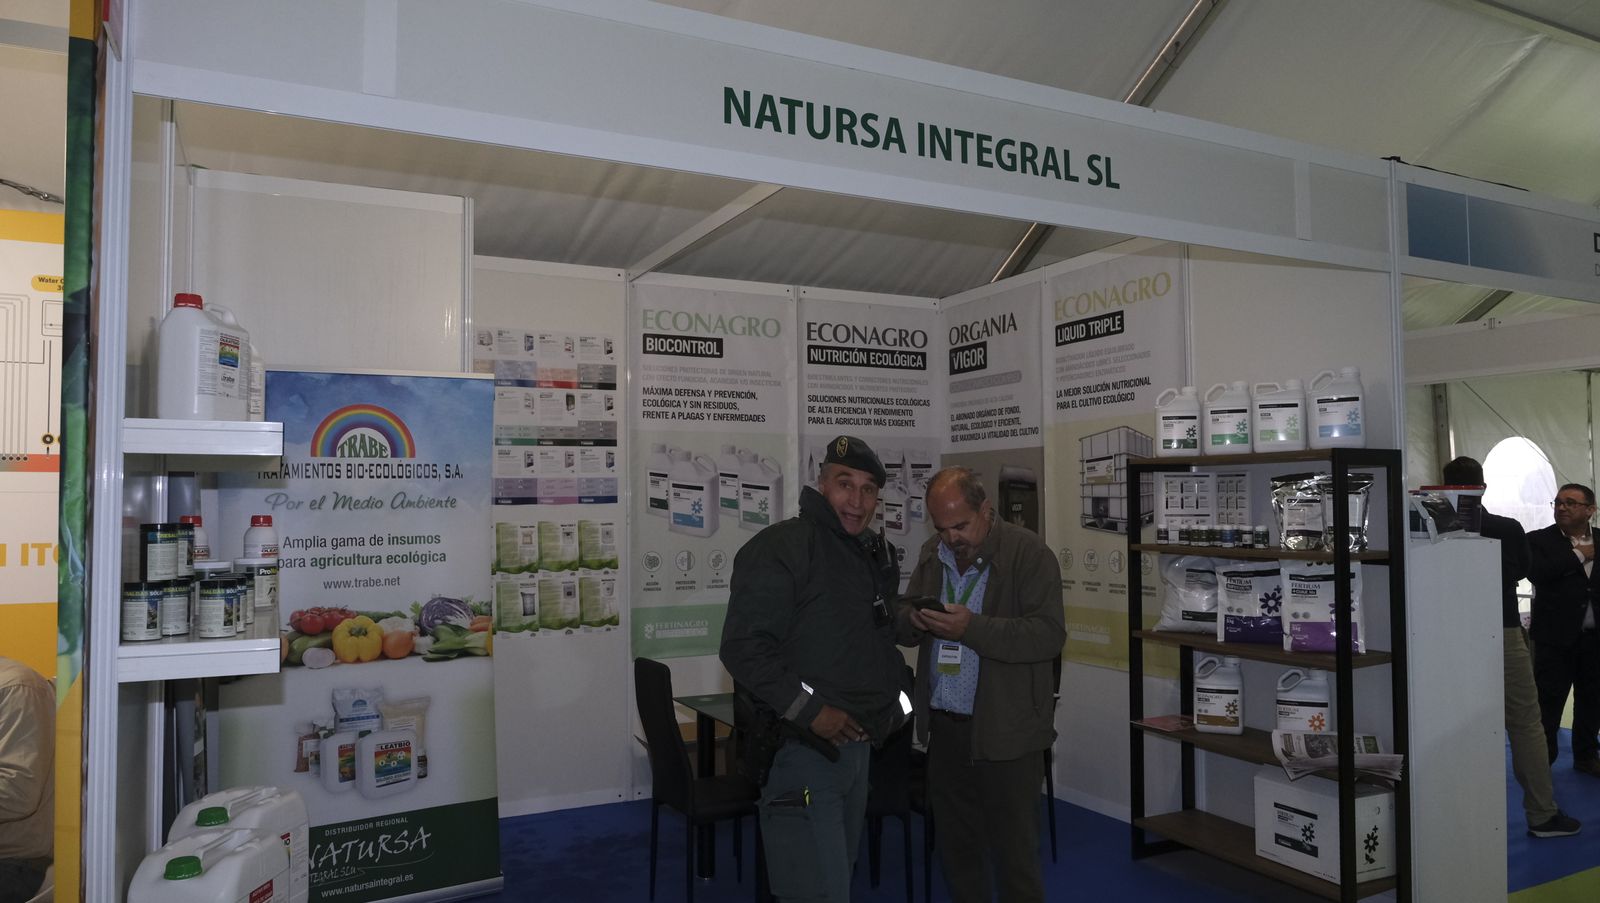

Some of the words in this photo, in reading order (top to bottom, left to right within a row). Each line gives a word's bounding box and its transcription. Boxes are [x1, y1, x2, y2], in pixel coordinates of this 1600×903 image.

[723, 86, 907, 154] NATURSA
[918, 122, 1079, 183] INTEGRAL
[1087, 154, 1120, 190] SL
[1055, 272, 1171, 320] ECONAGRO
[642, 309, 781, 338] ECONAGRO
[949, 312, 1017, 346] ORGANIA
[1058, 322, 1086, 343] LIQUID
[1088, 315, 1122, 336] TRIPLE
[806, 322, 928, 348] ECONAGRO
[646, 337, 720, 356] BIOCONTROL
[811, 348, 867, 364] NUTRICIÓN
[870, 350, 923, 367] ECOLÓGICA
[953, 347, 985, 370] VIGOR
[642, 386, 673, 396] MÁXIMA
[675, 388, 705, 397] DEFENSA
[707, 389, 712, 398] Y
[714, 389, 758, 400] PREVENCIÓN,
[1057, 390, 1063, 398] LA
[1064, 387, 1081, 397] MEJOR
[1082, 382, 1110, 394] SOLUCIÓN
[1112, 376, 1151, 391] NUTRICIONAL
[642, 398, 681, 408] ECOLÓGICA
[683, 400, 688, 408] Y
[690, 401, 702, 409] SIN
[703, 401, 740, 411] RESIDUOS,
[808, 395, 846, 404] SOLUCIONES
[848, 396, 894, 406] NUTRICIONALES
[896, 397, 930, 407] ECOLÓGICAS
[1057, 400, 1070, 410] PARA
[1072, 399, 1078, 408] EL
[1079, 396, 1101, 408] CULTIVO
[1103, 391, 1135, 404] ECOLÓGICO
[642, 410, 669, 419] FRENTE
[671, 411, 676, 419] A
[678, 412, 704, 420] PLAGAS
[713, 413, 766, 422] ENFERMEDADES
[874, 408, 913, 416] RENDIMIENTO
[956, 411, 975, 421] ABONADO
[976, 408, 997, 419] ORGÁNICO
[1004, 406, 1021, 415] FONDO,
[874, 418, 887, 426] MÁS
[888, 419, 916, 428] EXIGENTE
[951, 423, 970, 432] NATURAL,
[971, 419, 993, 430] ECOLÓGICO
[998, 417, 1022, 426] EFICIENTE,
[960, 433, 980, 442] MAXIMIZA
[987, 429, 1009, 439] VITALIDAD
[1010, 429, 1018, 437] DEL
[1020, 427, 1039, 436] CULTIVO
[337, 432, 389, 458] TRABE
[444, 463, 464, 479] S.A.
[264, 492, 304, 511] Por
[310, 492, 326, 510] el
[332, 491, 383, 511] Medio
[390, 491, 457, 511] Ambiente
[283, 534, 327, 550] Amplia
[331, 537, 366, 550] gama
[369, 533, 384, 547] de
[388, 533, 441, 546] insumos
[277, 555, 306, 571] para
[310, 552, 383, 570] agricultura
[386, 550, 447, 567] ecológica
[323, 576, 401, 591] www.trabe.net
[325, 822, 373, 837] DISTRIBUIDOR
[375, 817, 409, 828] REGIONAL
[310, 826, 431, 870] NATURSA
[321, 872, 414, 898] www.natursaintegral.es
